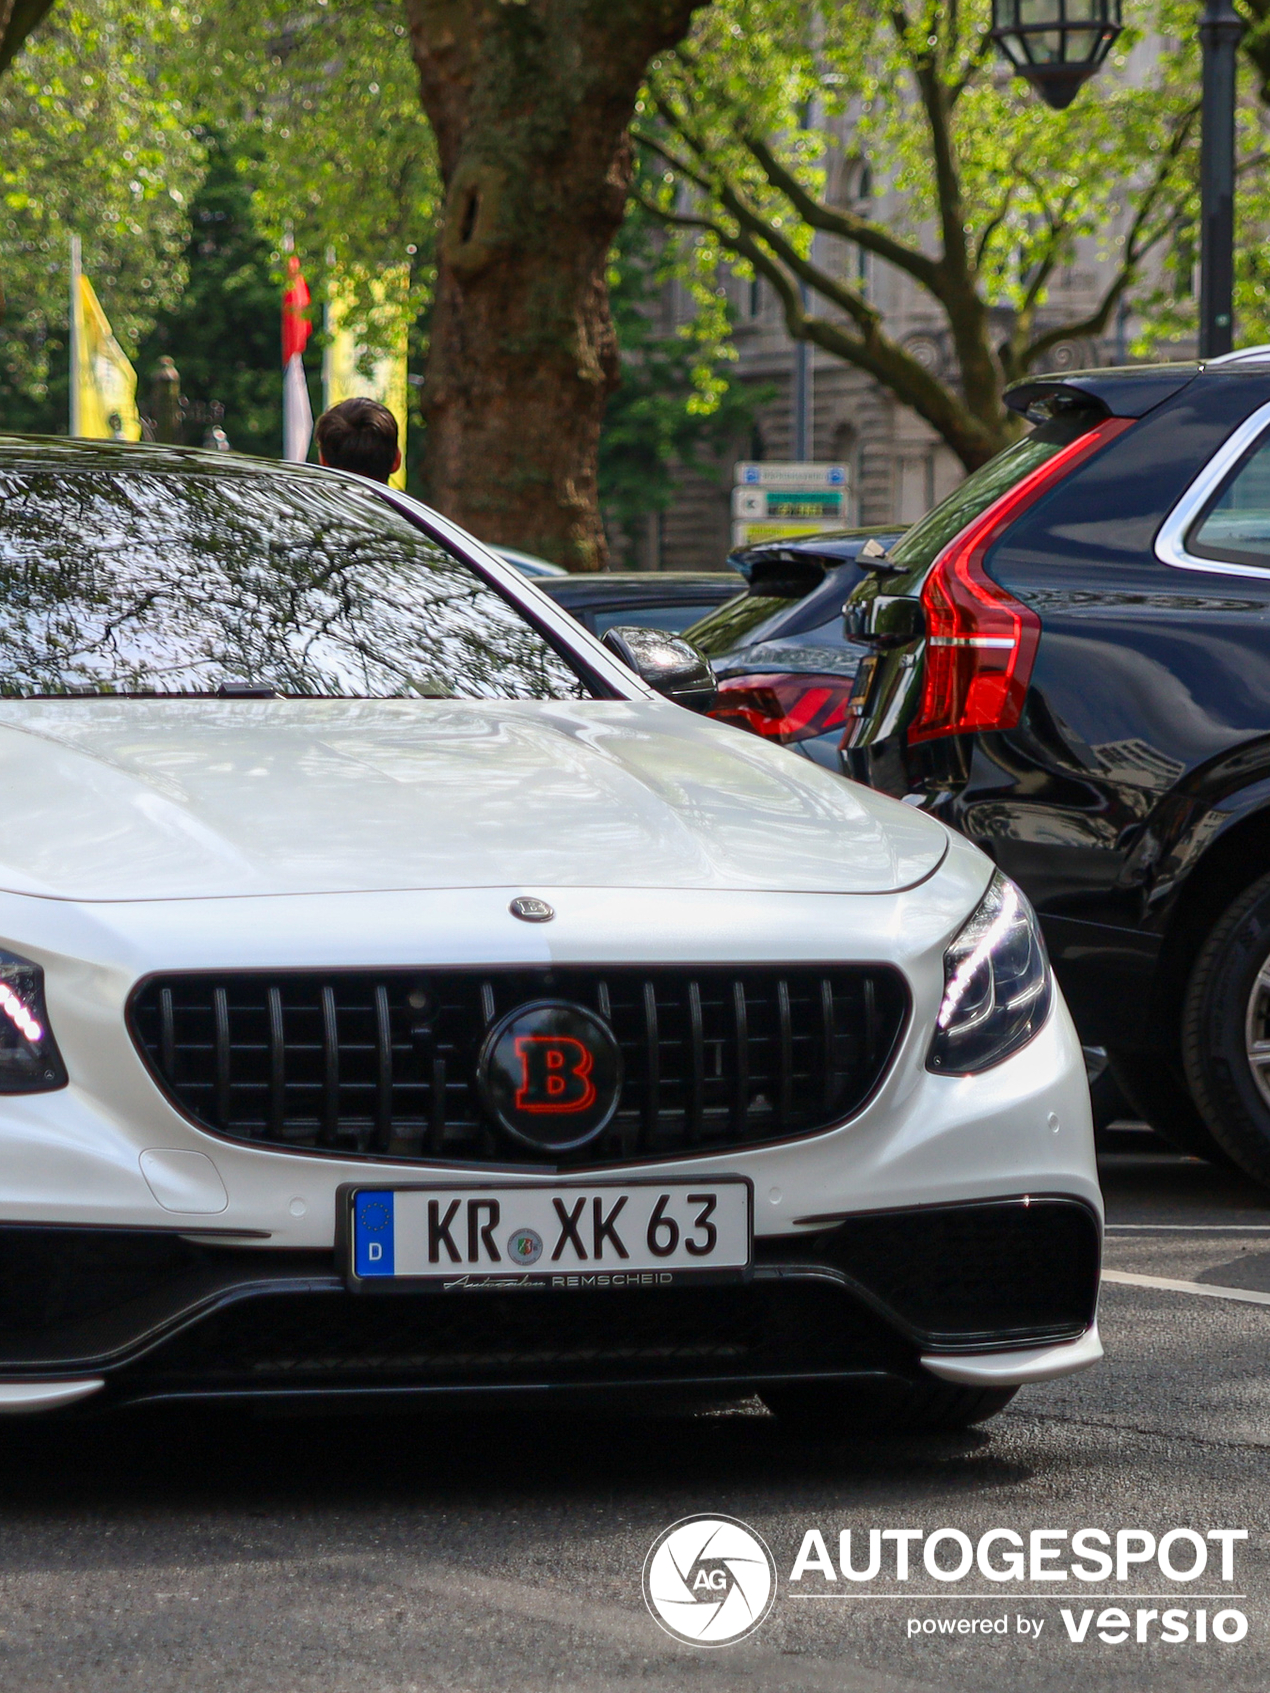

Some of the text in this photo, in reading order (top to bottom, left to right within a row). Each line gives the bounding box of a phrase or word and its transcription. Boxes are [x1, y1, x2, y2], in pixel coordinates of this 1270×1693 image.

[515, 1036, 597, 1113] B
[427, 1198, 501, 1263] KR
[550, 1195, 630, 1261] XK
[646, 1193, 718, 1257] 63
[368, 1242, 383, 1261] D
[551, 1273, 674, 1287] REMSCHEID
